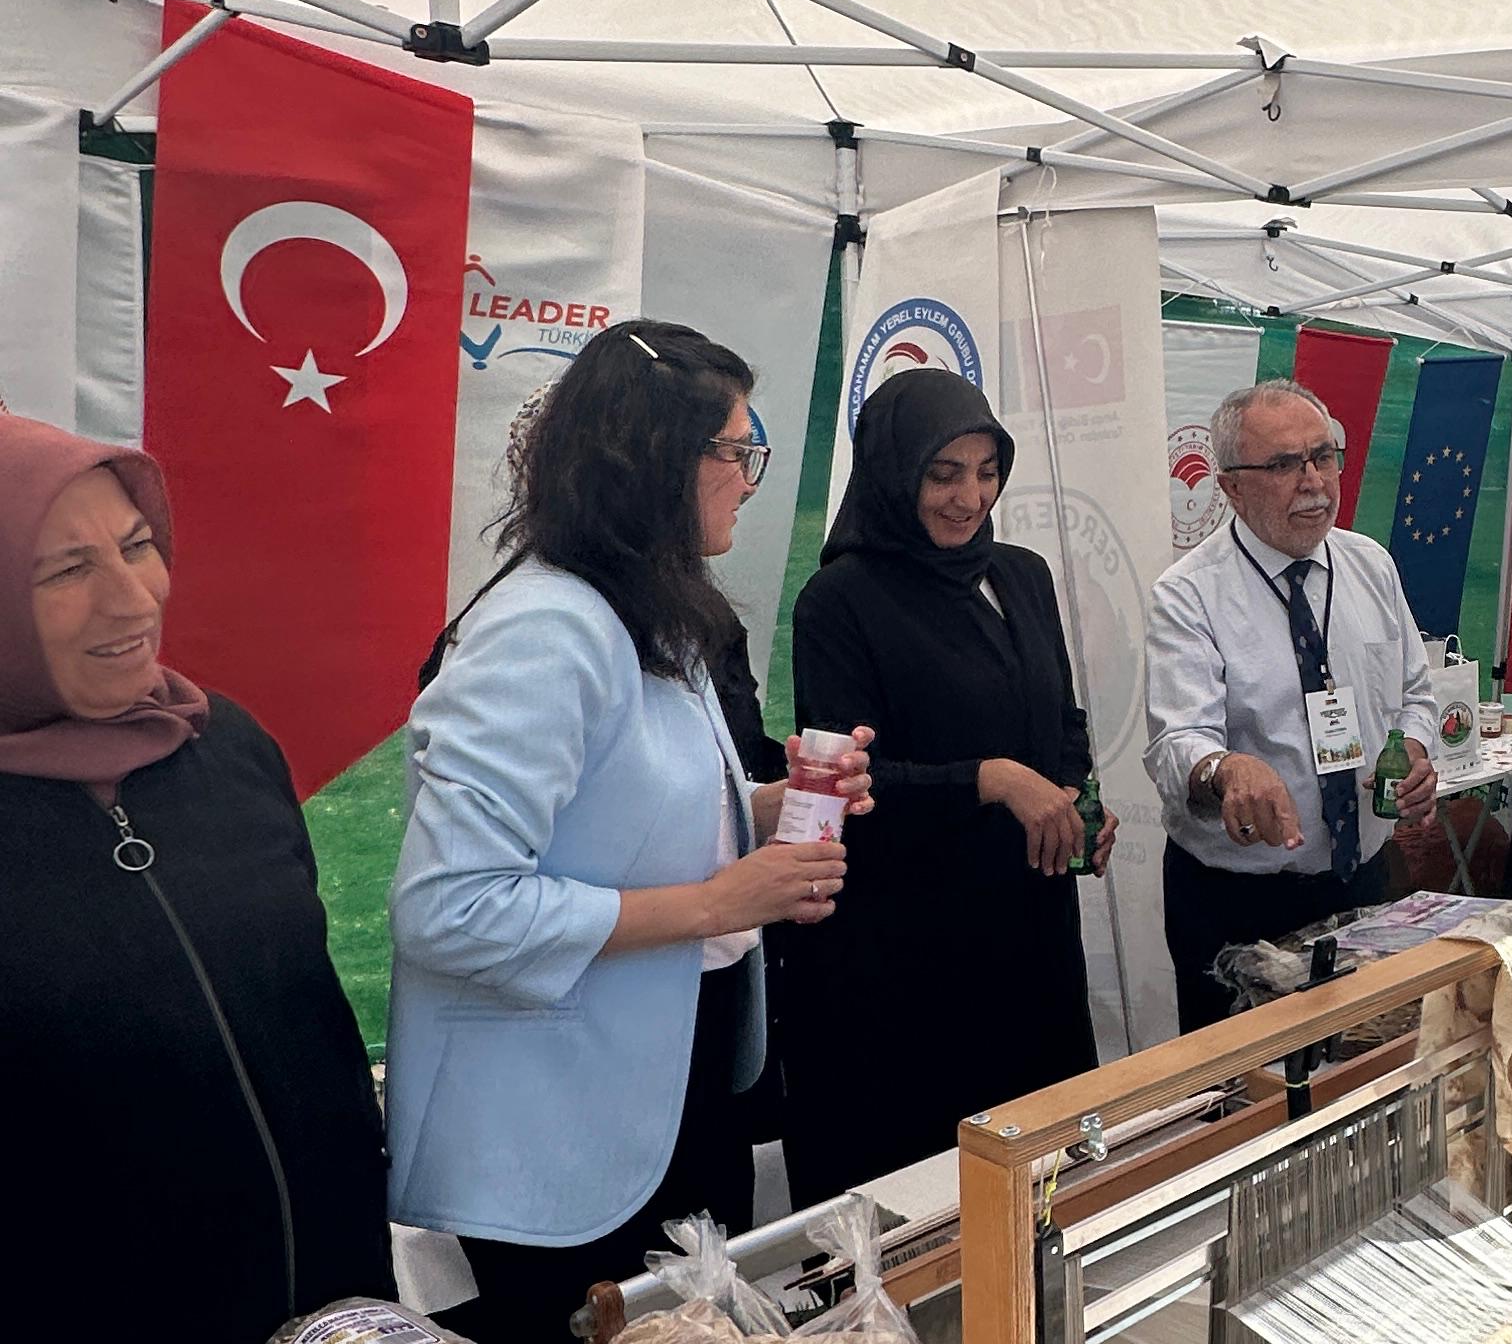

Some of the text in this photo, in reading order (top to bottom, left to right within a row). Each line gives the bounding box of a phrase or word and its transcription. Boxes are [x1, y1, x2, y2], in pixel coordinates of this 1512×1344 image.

[469, 292, 610, 329] LEADER
[880, 308, 913, 335] YEREL
[914, 307, 949, 329] EYLEM
[948, 323, 974, 367] GRUBU
